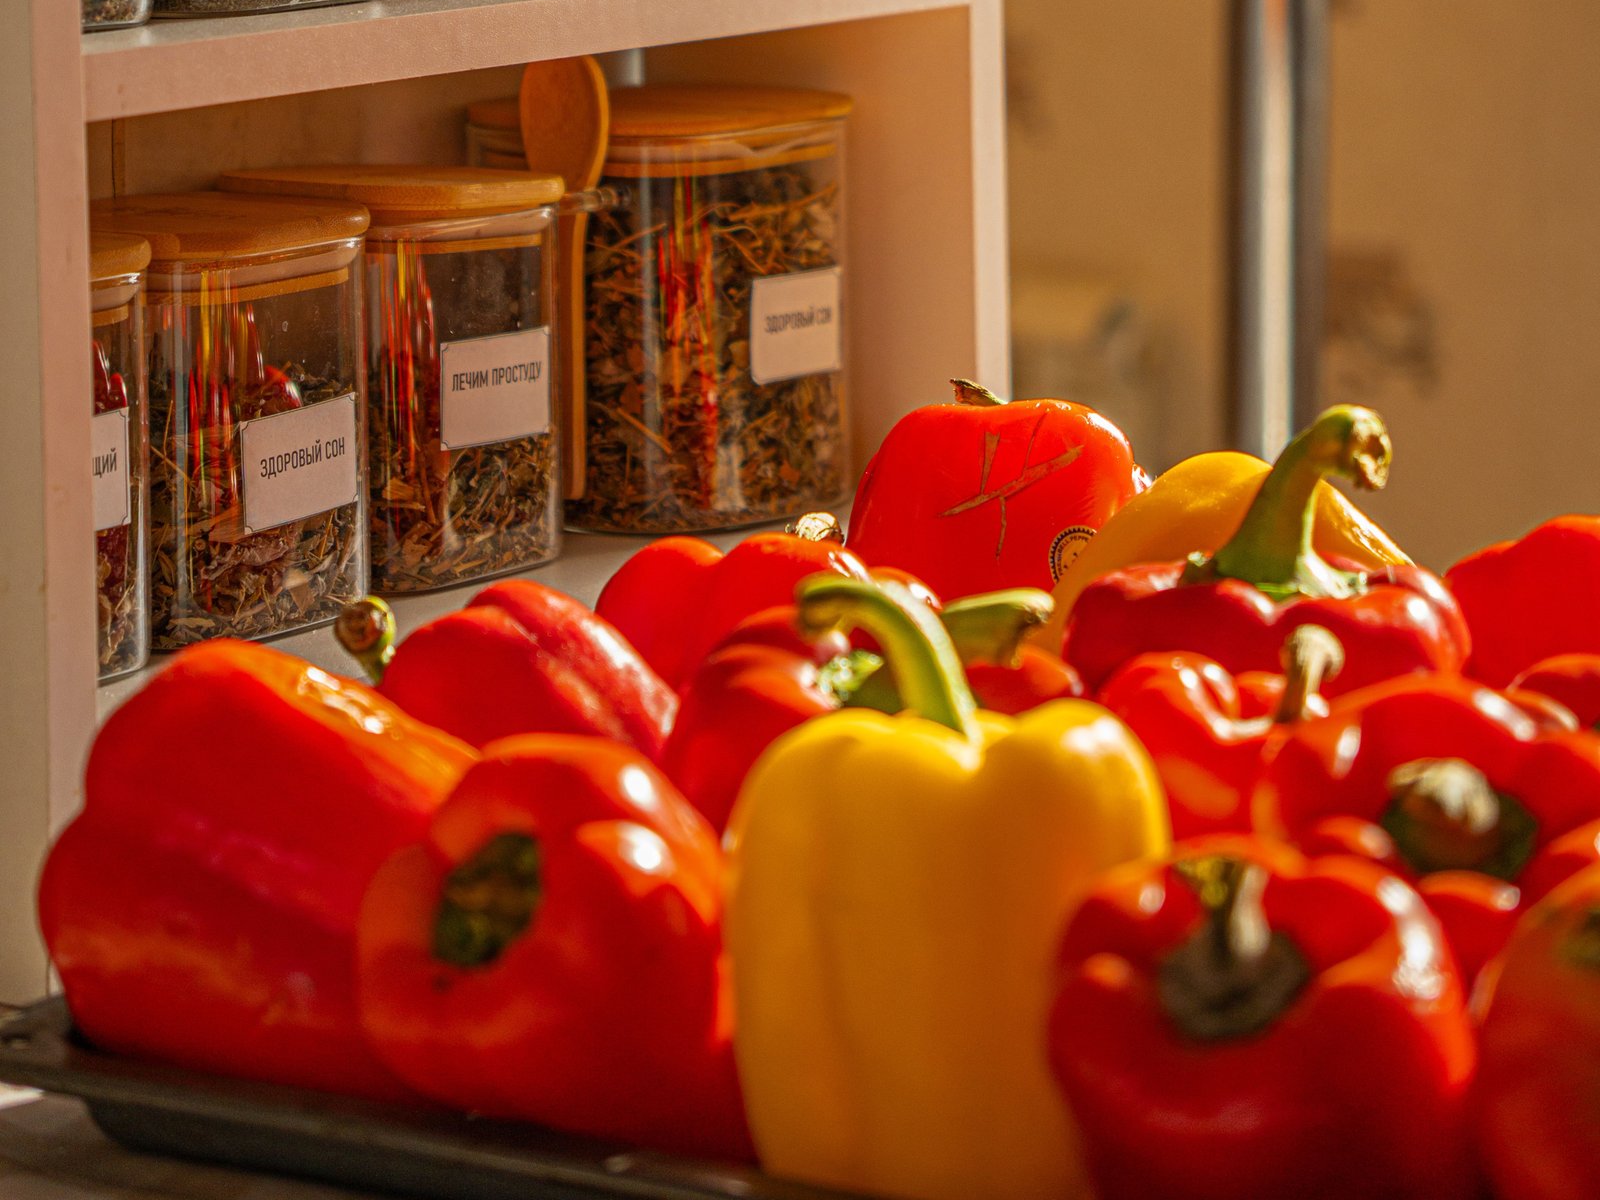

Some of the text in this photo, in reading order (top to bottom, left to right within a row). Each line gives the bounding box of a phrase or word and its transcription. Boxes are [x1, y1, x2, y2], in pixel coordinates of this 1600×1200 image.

[765, 305, 814, 334] ЗДОРОВЫЙ
[452, 360, 542, 393] ЛЕЧИМ ПРОСТУДУ
[92, 447, 117, 479] ЩИЙ
[260, 436, 345, 479] ЗДОРОВЫЙ СОН
